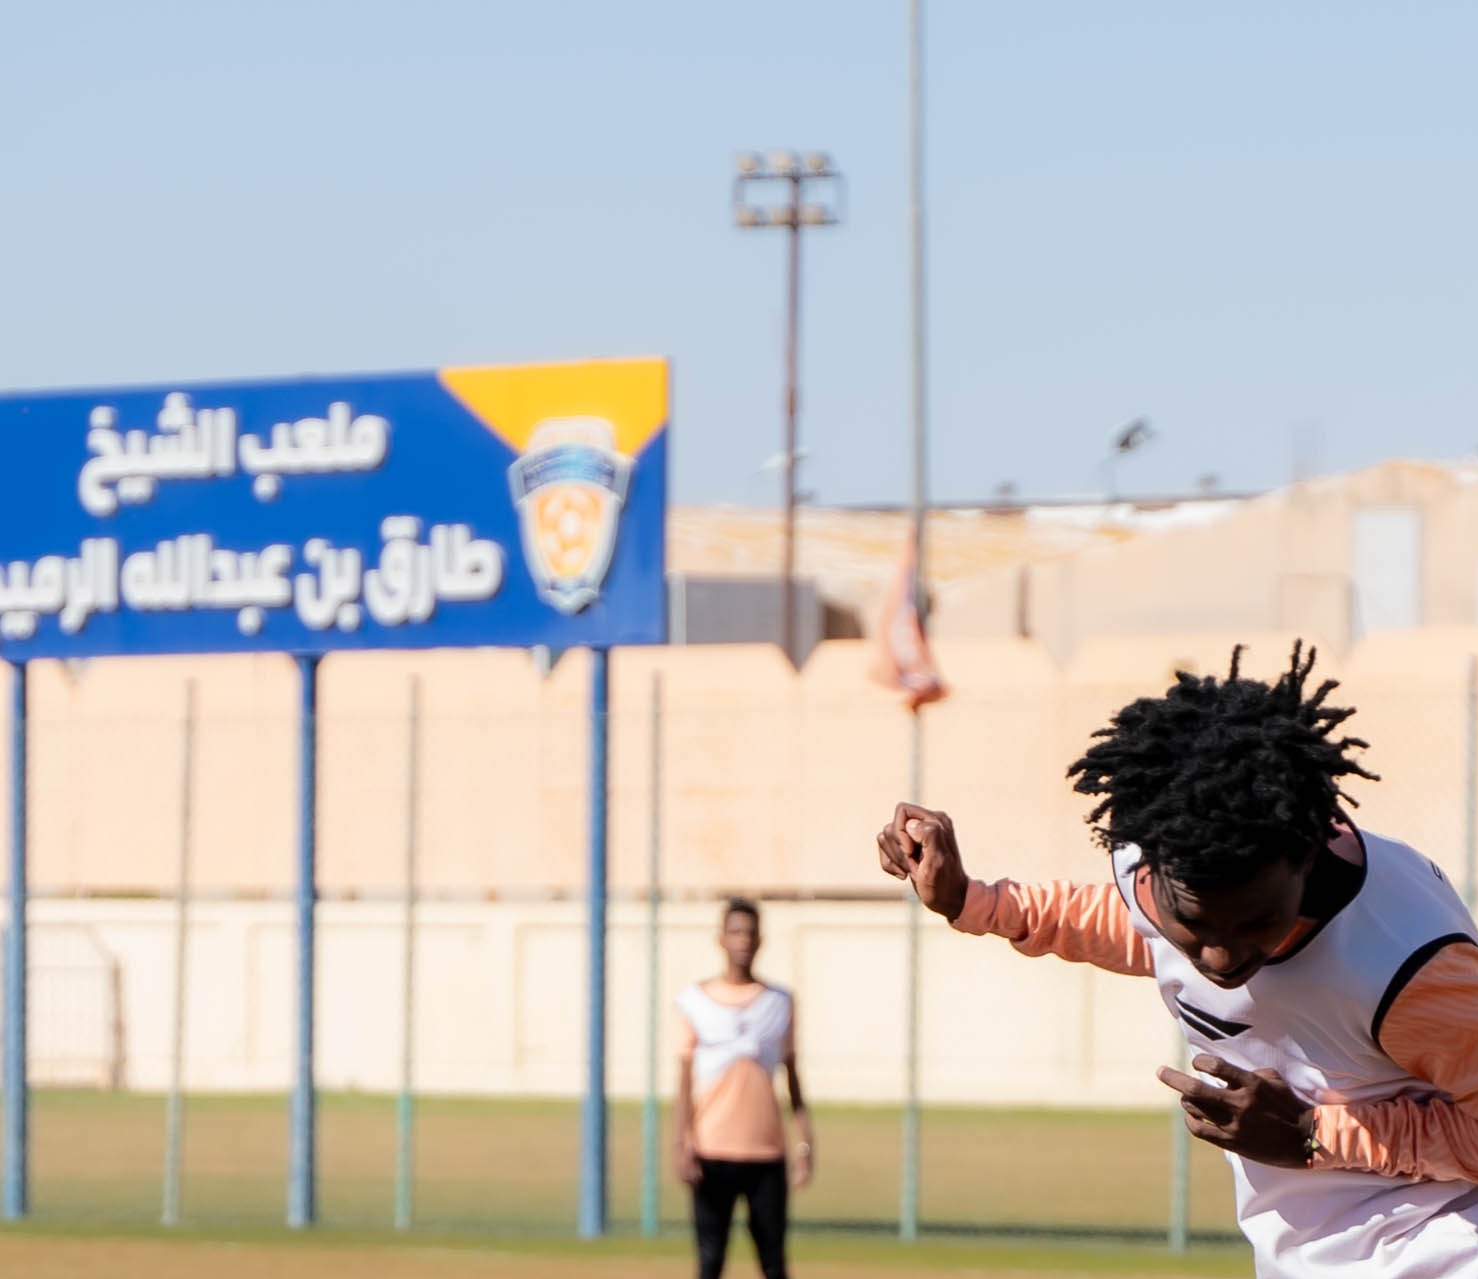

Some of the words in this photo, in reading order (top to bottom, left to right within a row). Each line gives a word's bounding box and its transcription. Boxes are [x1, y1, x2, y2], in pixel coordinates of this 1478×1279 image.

[79, 391, 236, 517] الشيخ
[238, 401, 390, 501] ملعب
[0, 537, 118, 640] الرمي
[121, 533, 293, 636] عبدالله
[294, 537, 361, 632] بن
[364, 515, 503, 626] طارق
